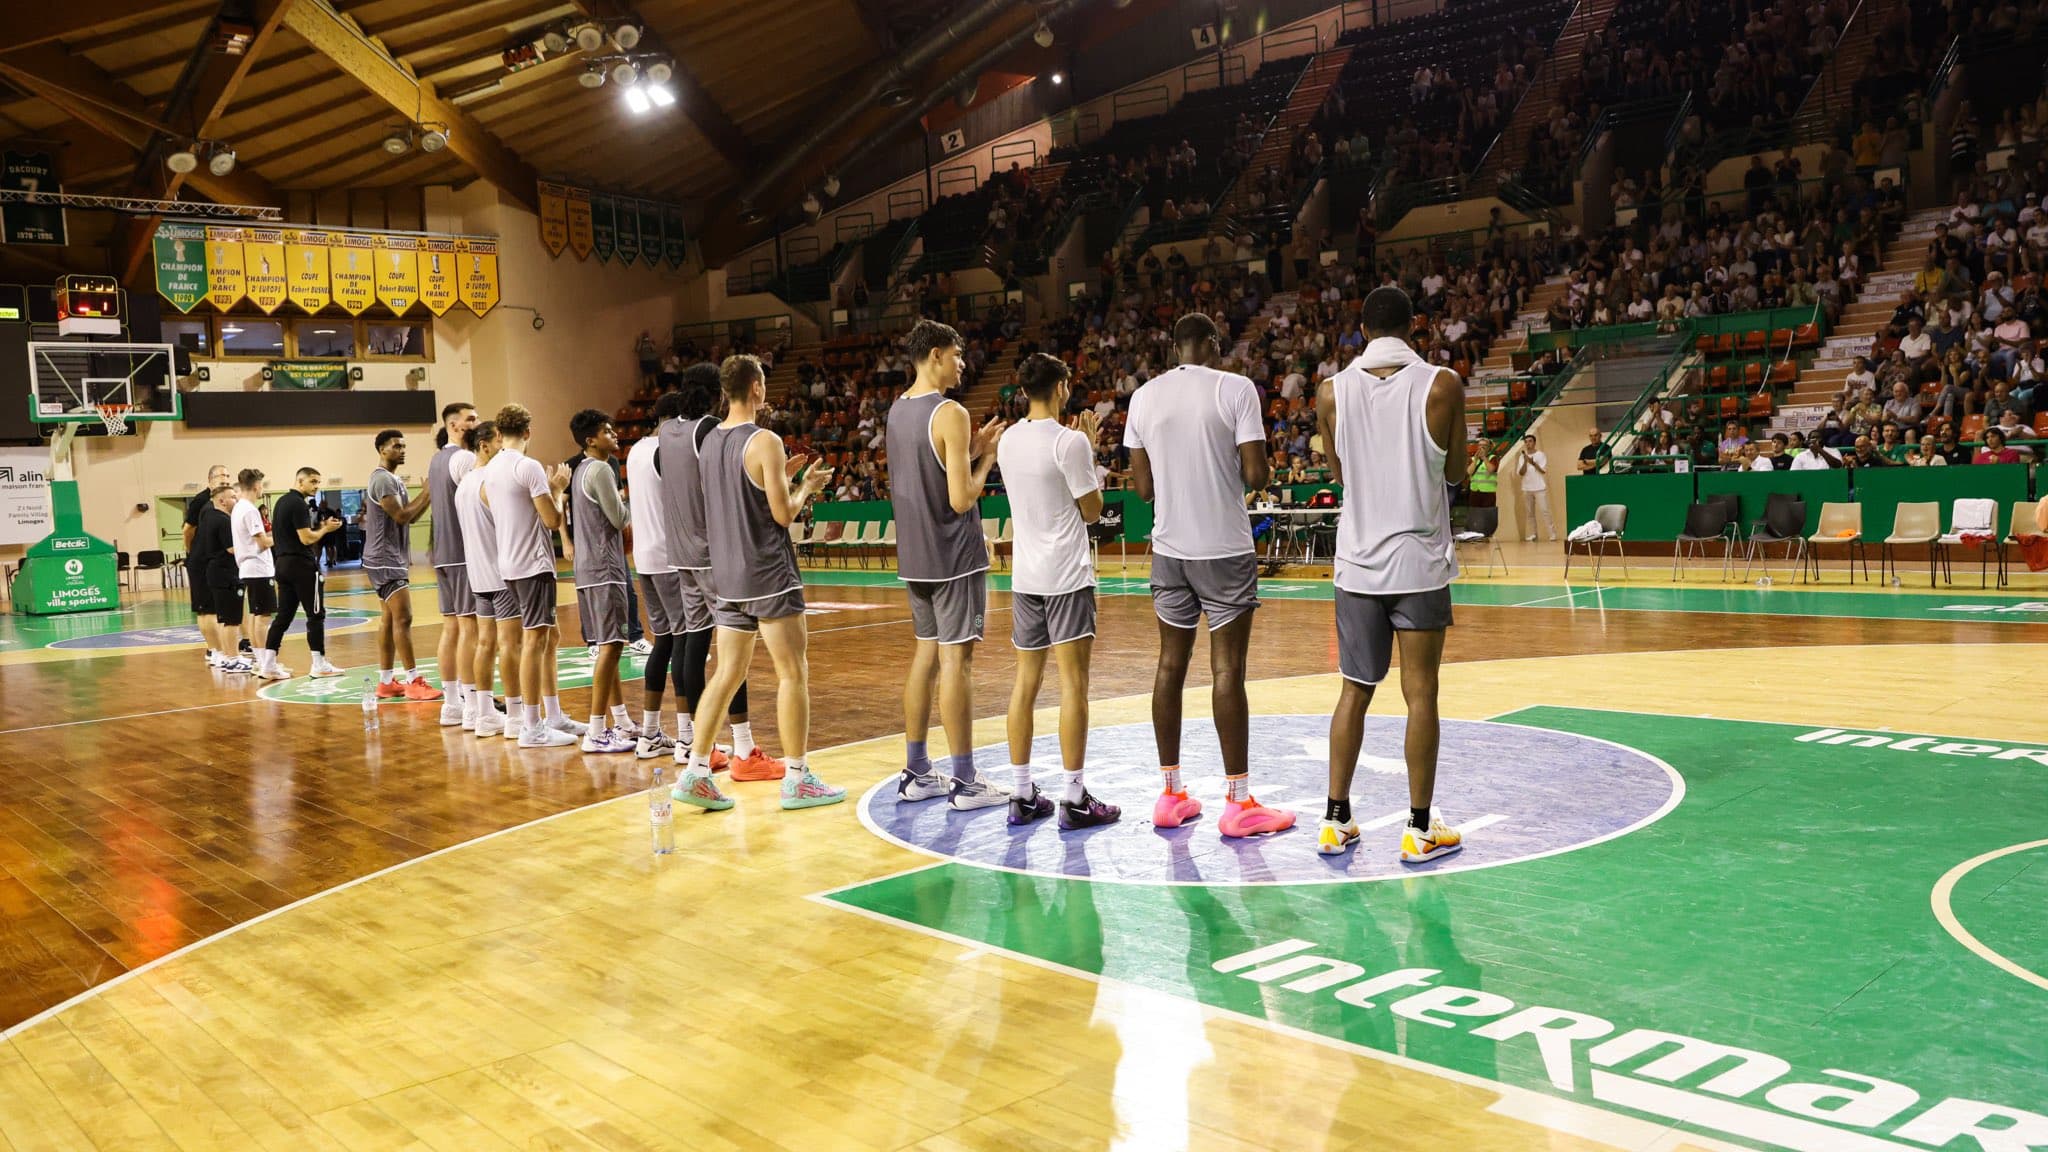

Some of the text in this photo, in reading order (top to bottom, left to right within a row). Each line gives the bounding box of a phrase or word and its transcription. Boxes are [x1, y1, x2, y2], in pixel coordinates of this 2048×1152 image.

[1200, 28, 1211, 44] 4
[948, 134, 960, 149] 2
[20, 178, 38, 203] 7
[255, 232, 282, 241] LIMOGE
[301, 235, 329, 243] LIMOGE
[160, 263, 203, 272] CHAMPION
[210, 268, 241, 276] AMPION
[301, 272, 318, 280] COUPE
[388, 272, 406, 280] COUPE
[178, 273, 188, 281] DE
[335, 273, 371, 281] CHAMPION
[168, 282, 198, 291] FRANCE
[210, 284, 236, 292] RANCE
[342, 288, 366, 296] FRANCE
[31, 512, 48, 520] Villag
[55, 540, 87, 549] Betclic
[52, 587, 100, 599] LIMOGES
[47, 596, 107, 607] ville sportive
